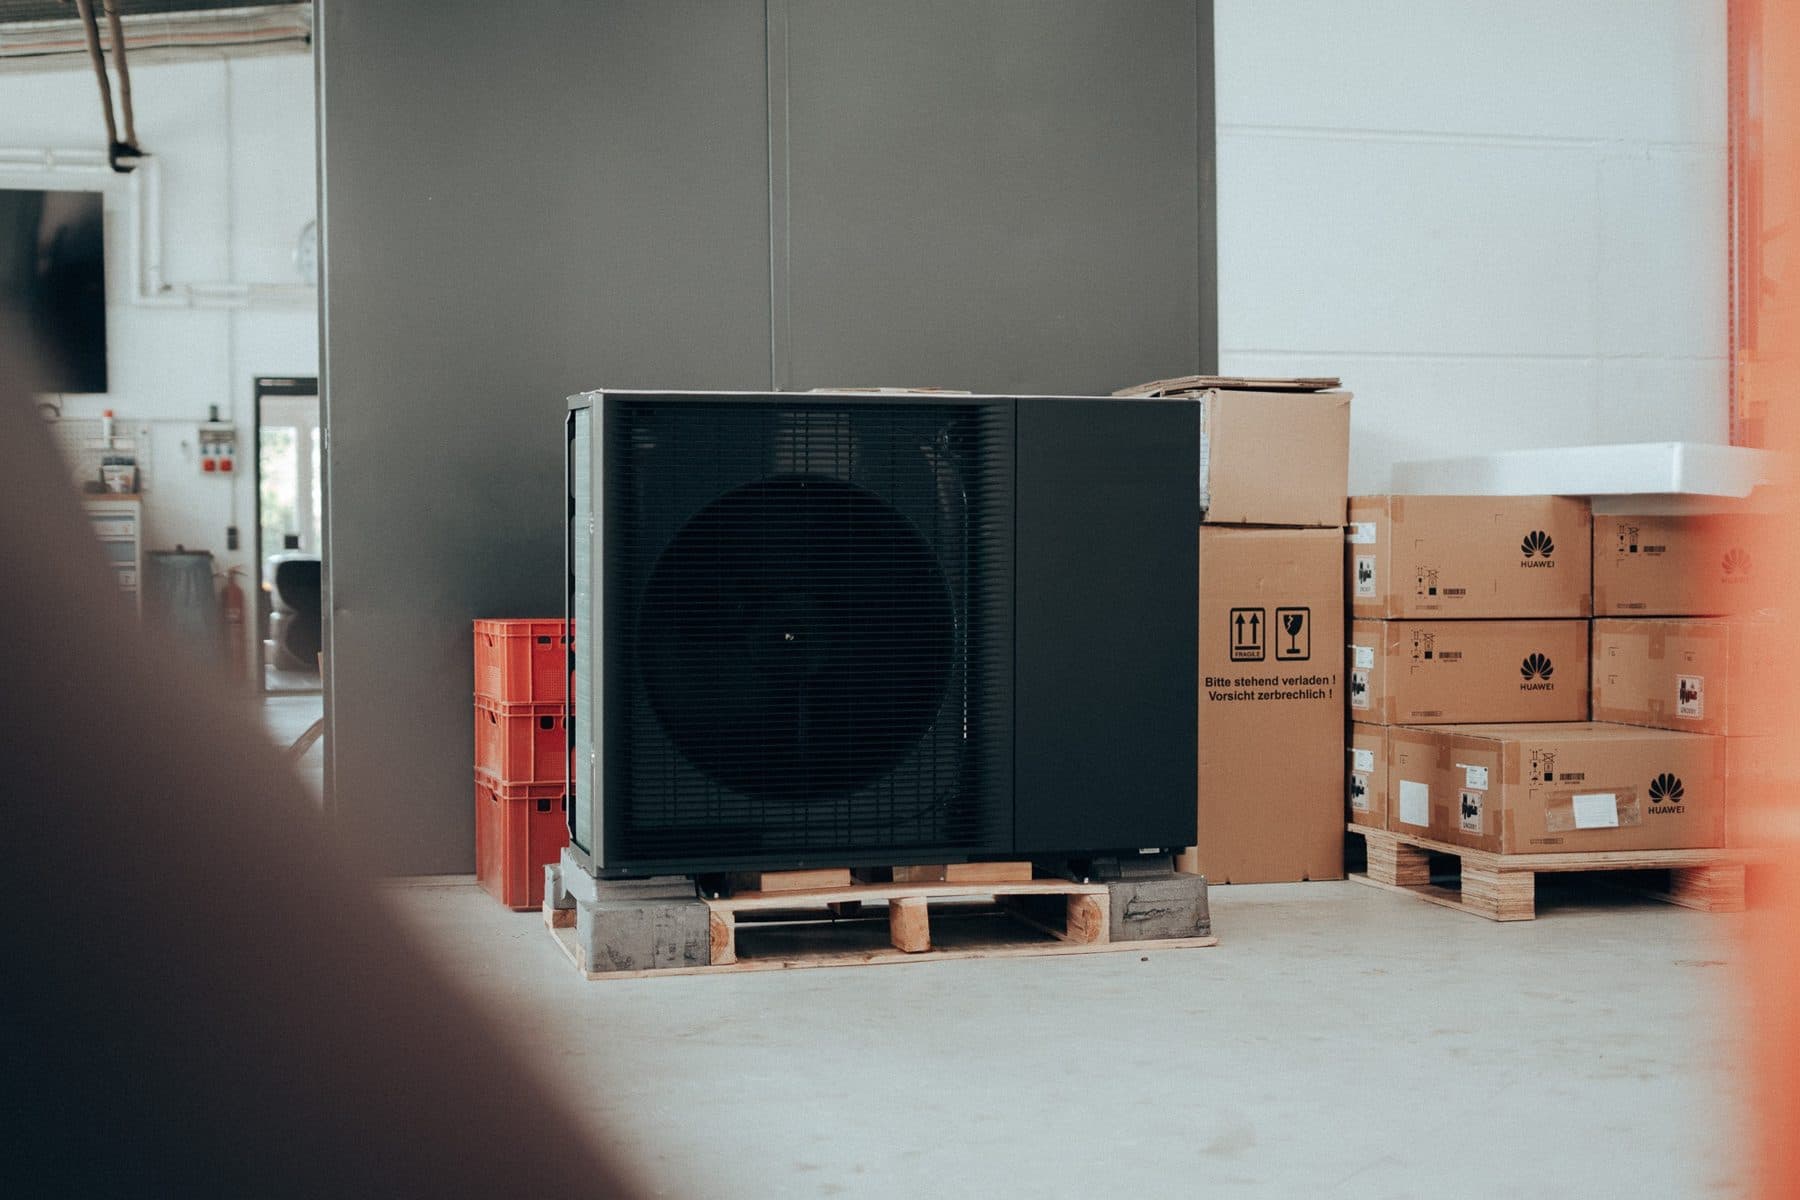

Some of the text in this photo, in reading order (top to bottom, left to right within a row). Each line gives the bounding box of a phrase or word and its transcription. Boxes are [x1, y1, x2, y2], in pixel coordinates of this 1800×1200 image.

[1520, 560, 1555, 568] HUAWEI
[1205, 675, 1336, 687] Bitte stehend verladen !
[1208, 688, 1333, 701] Vorsicht zerbrechlich !
[1647, 805, 1685, 815] HUAWEI
